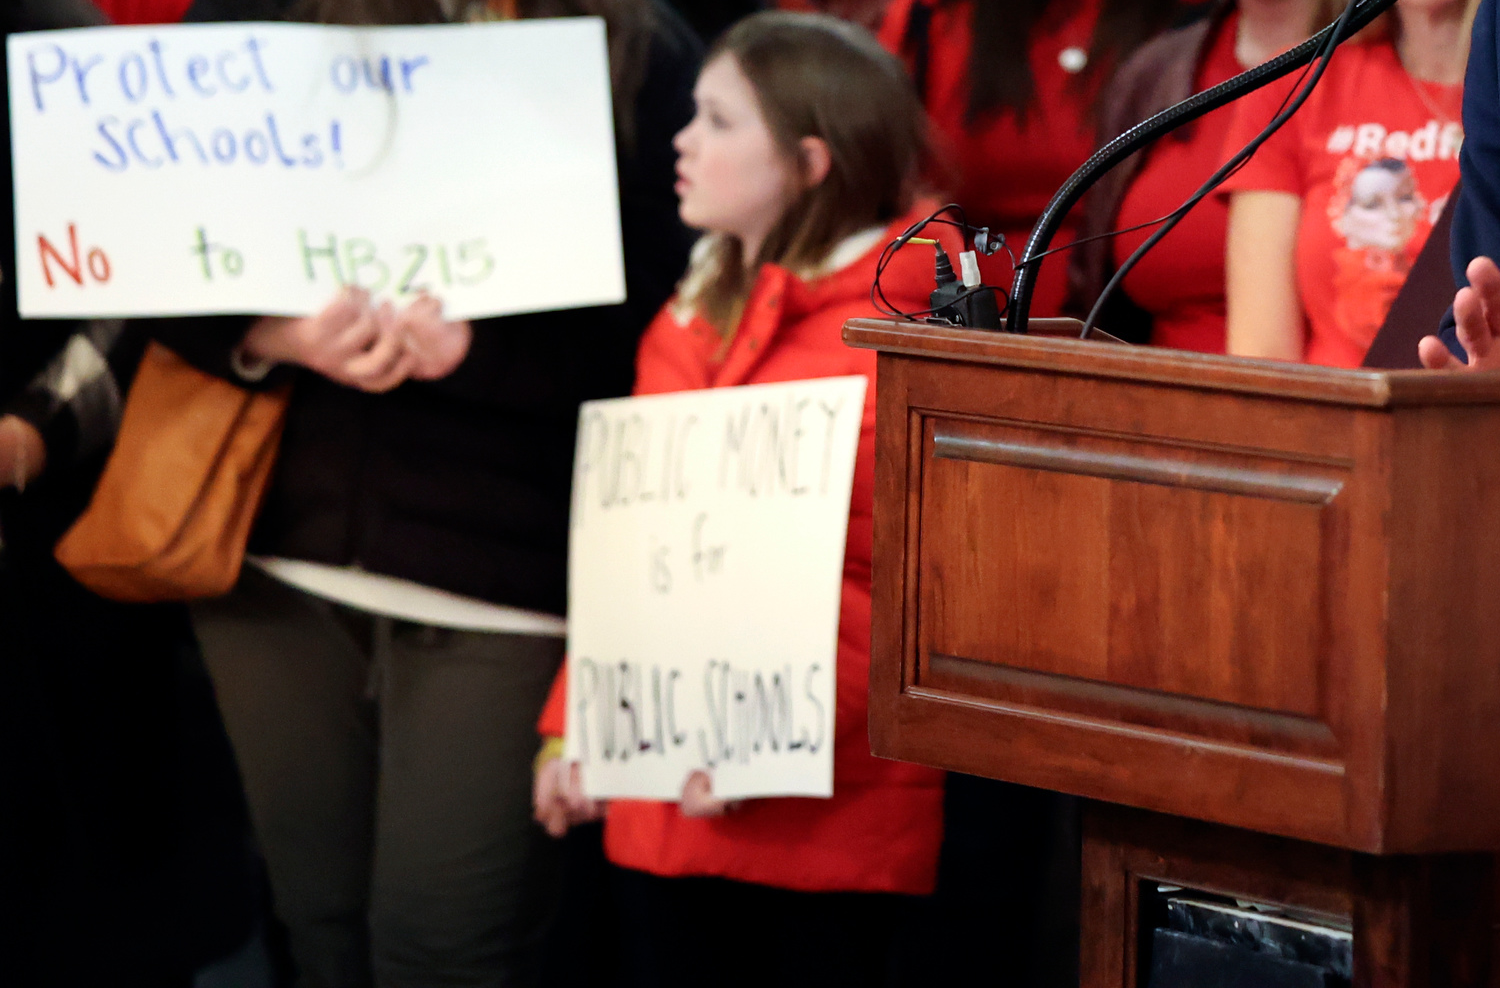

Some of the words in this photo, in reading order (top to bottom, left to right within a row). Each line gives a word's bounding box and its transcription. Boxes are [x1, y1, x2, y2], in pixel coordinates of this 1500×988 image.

[26, 36, 275, 111] Protect
[330, 51, 431, 97] our
[37, 222, 113, 289] No
[190, 225, 244, 280] to
[574, 409, 699, 528] PUBLIC
[717, 392, 846, 498] MONEY
[650, 534, 673, 595] is
[691, 511, 727, 582] for
[577, 657, 688, 765] PUBLIC
[698, 658, 826, 769] SCHOOLS
